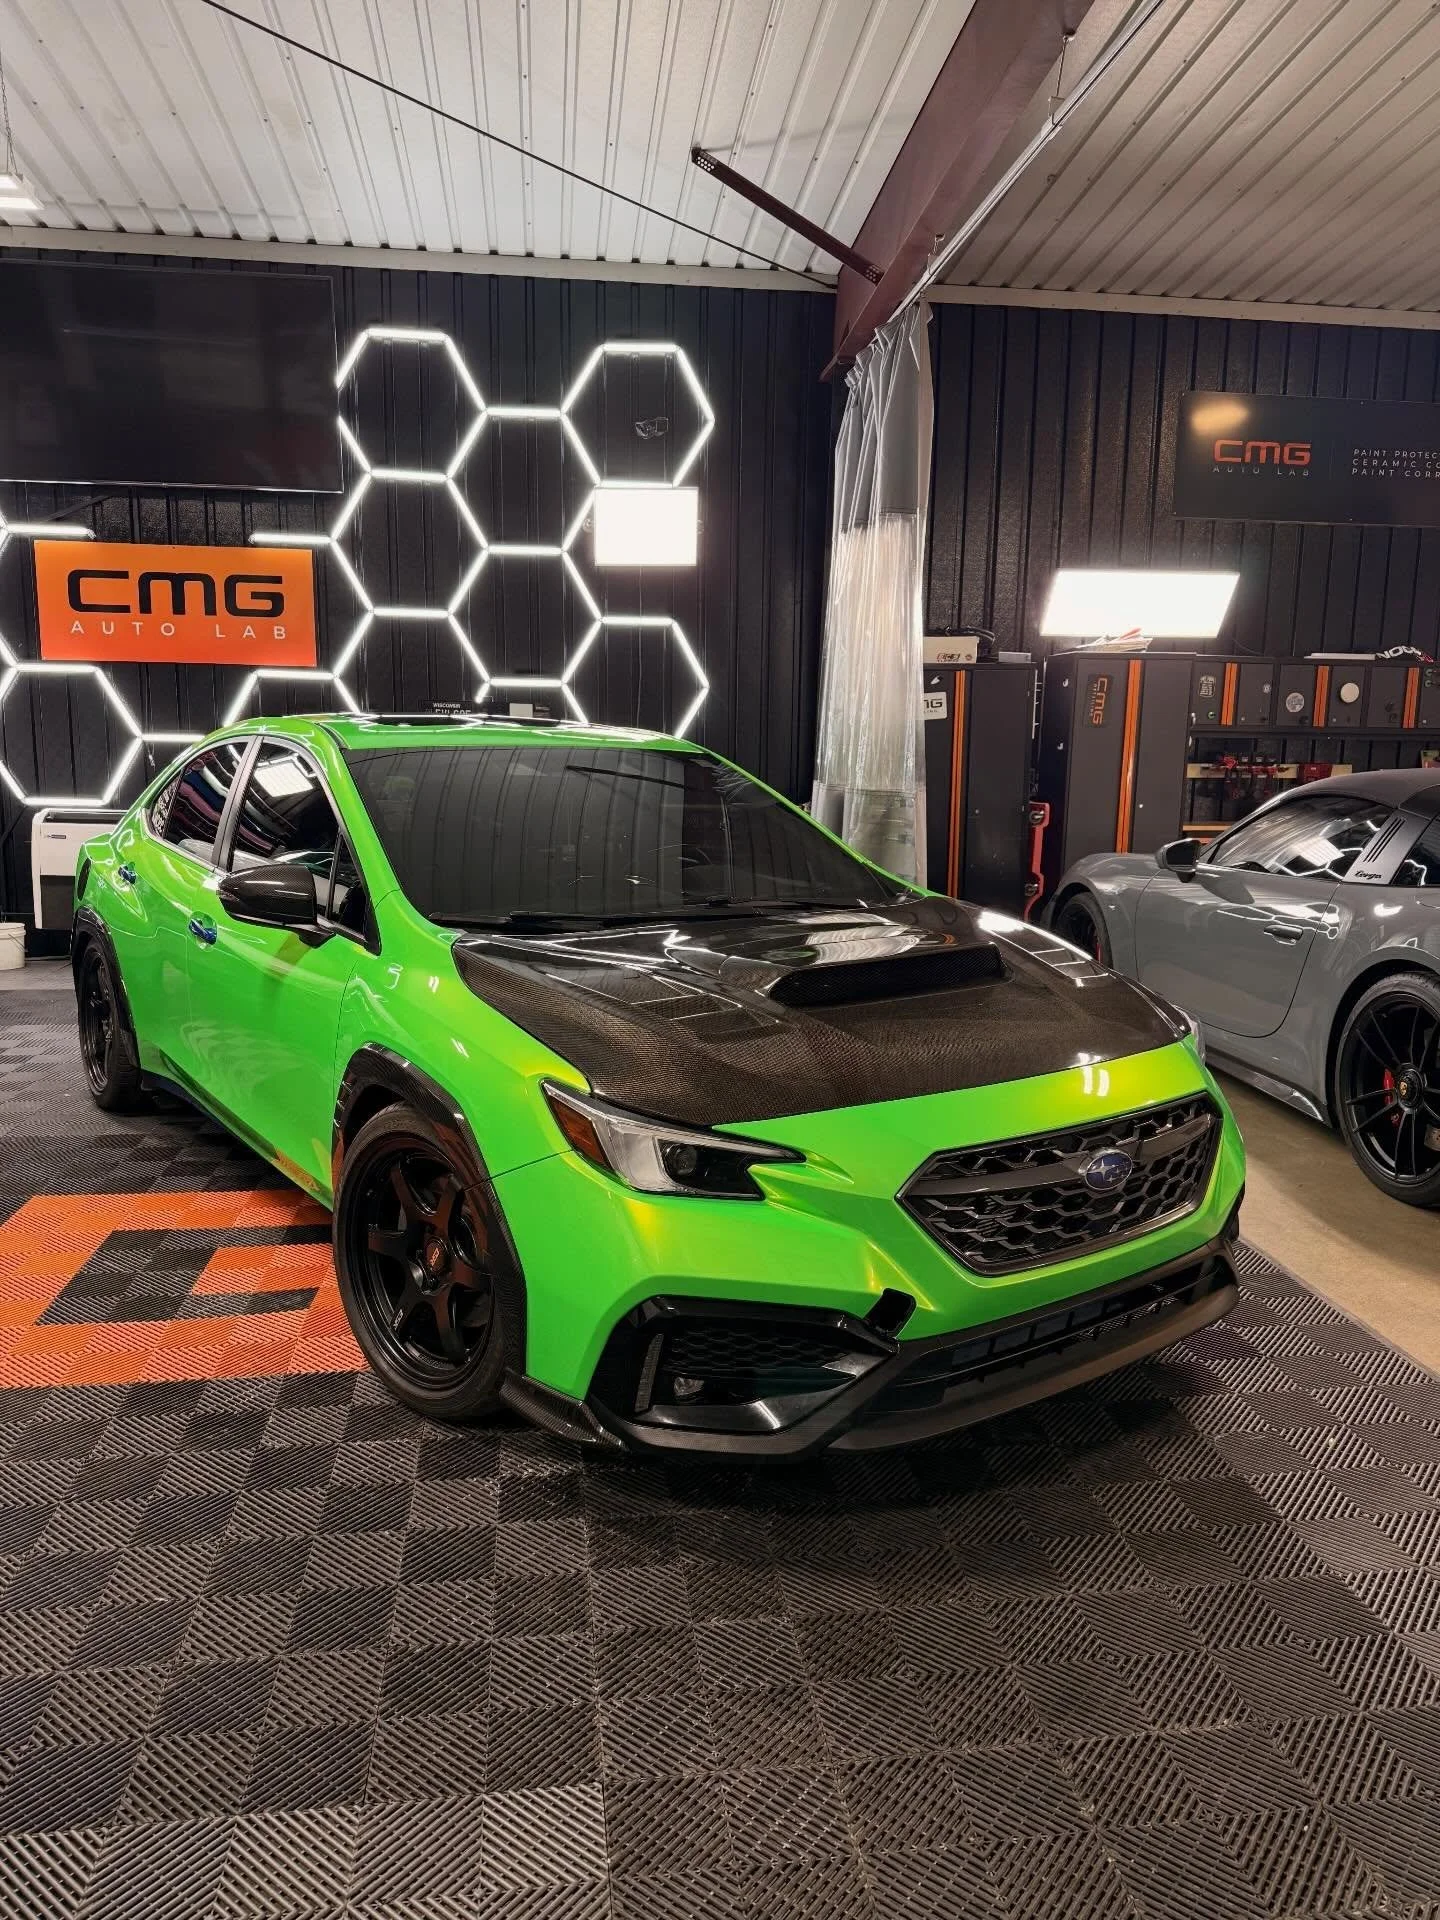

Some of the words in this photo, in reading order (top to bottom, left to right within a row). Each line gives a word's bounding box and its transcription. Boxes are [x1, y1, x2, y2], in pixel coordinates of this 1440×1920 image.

[1214, 439, 1311, 465] CMG
[1353, 448, 1387, 457] PAINT
[1394, 450, 1440, 459] PROTEC
[1212, 464, 1260, 474] AUTO
[1277, 467, 1309, 476] LAB
[1352, 458, 1417, 468] CERAMIC
[1352, 468, 1395, 477] PAINT
[67, 569, 285, 618] CMG
[70, 620, 175, 637] AUTO
[215, 623, 286, 640] LAB
[1092, 677, 1108, 725] CMG
